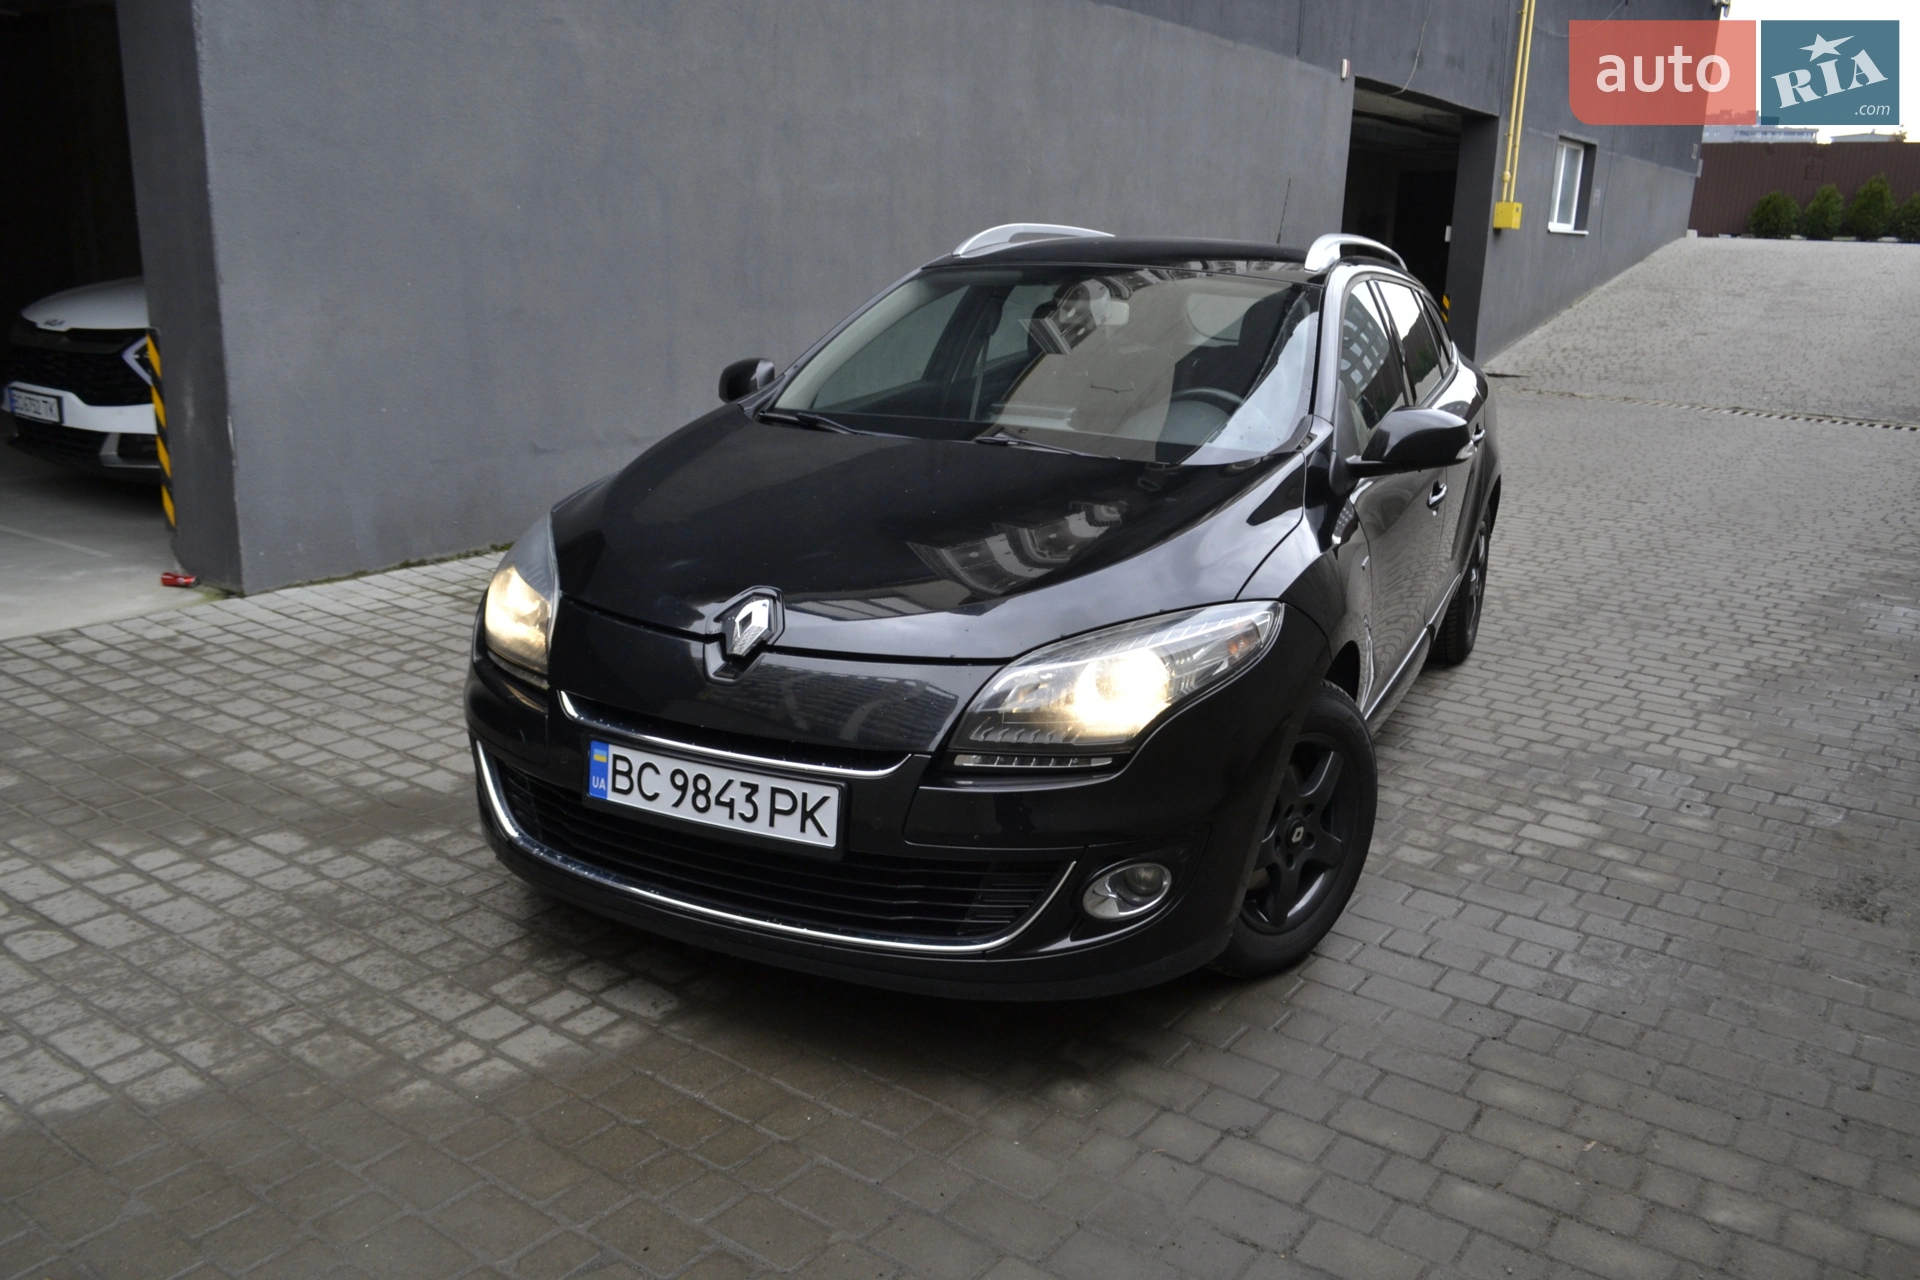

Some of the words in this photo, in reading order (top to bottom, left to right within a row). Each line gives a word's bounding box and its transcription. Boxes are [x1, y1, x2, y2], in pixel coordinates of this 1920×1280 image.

[592, 775, 607, 791] UA
[611, 753, 661, 802] BC
[669, 768, 760, 823] 9843
[768, 786, 831, 838] PK
